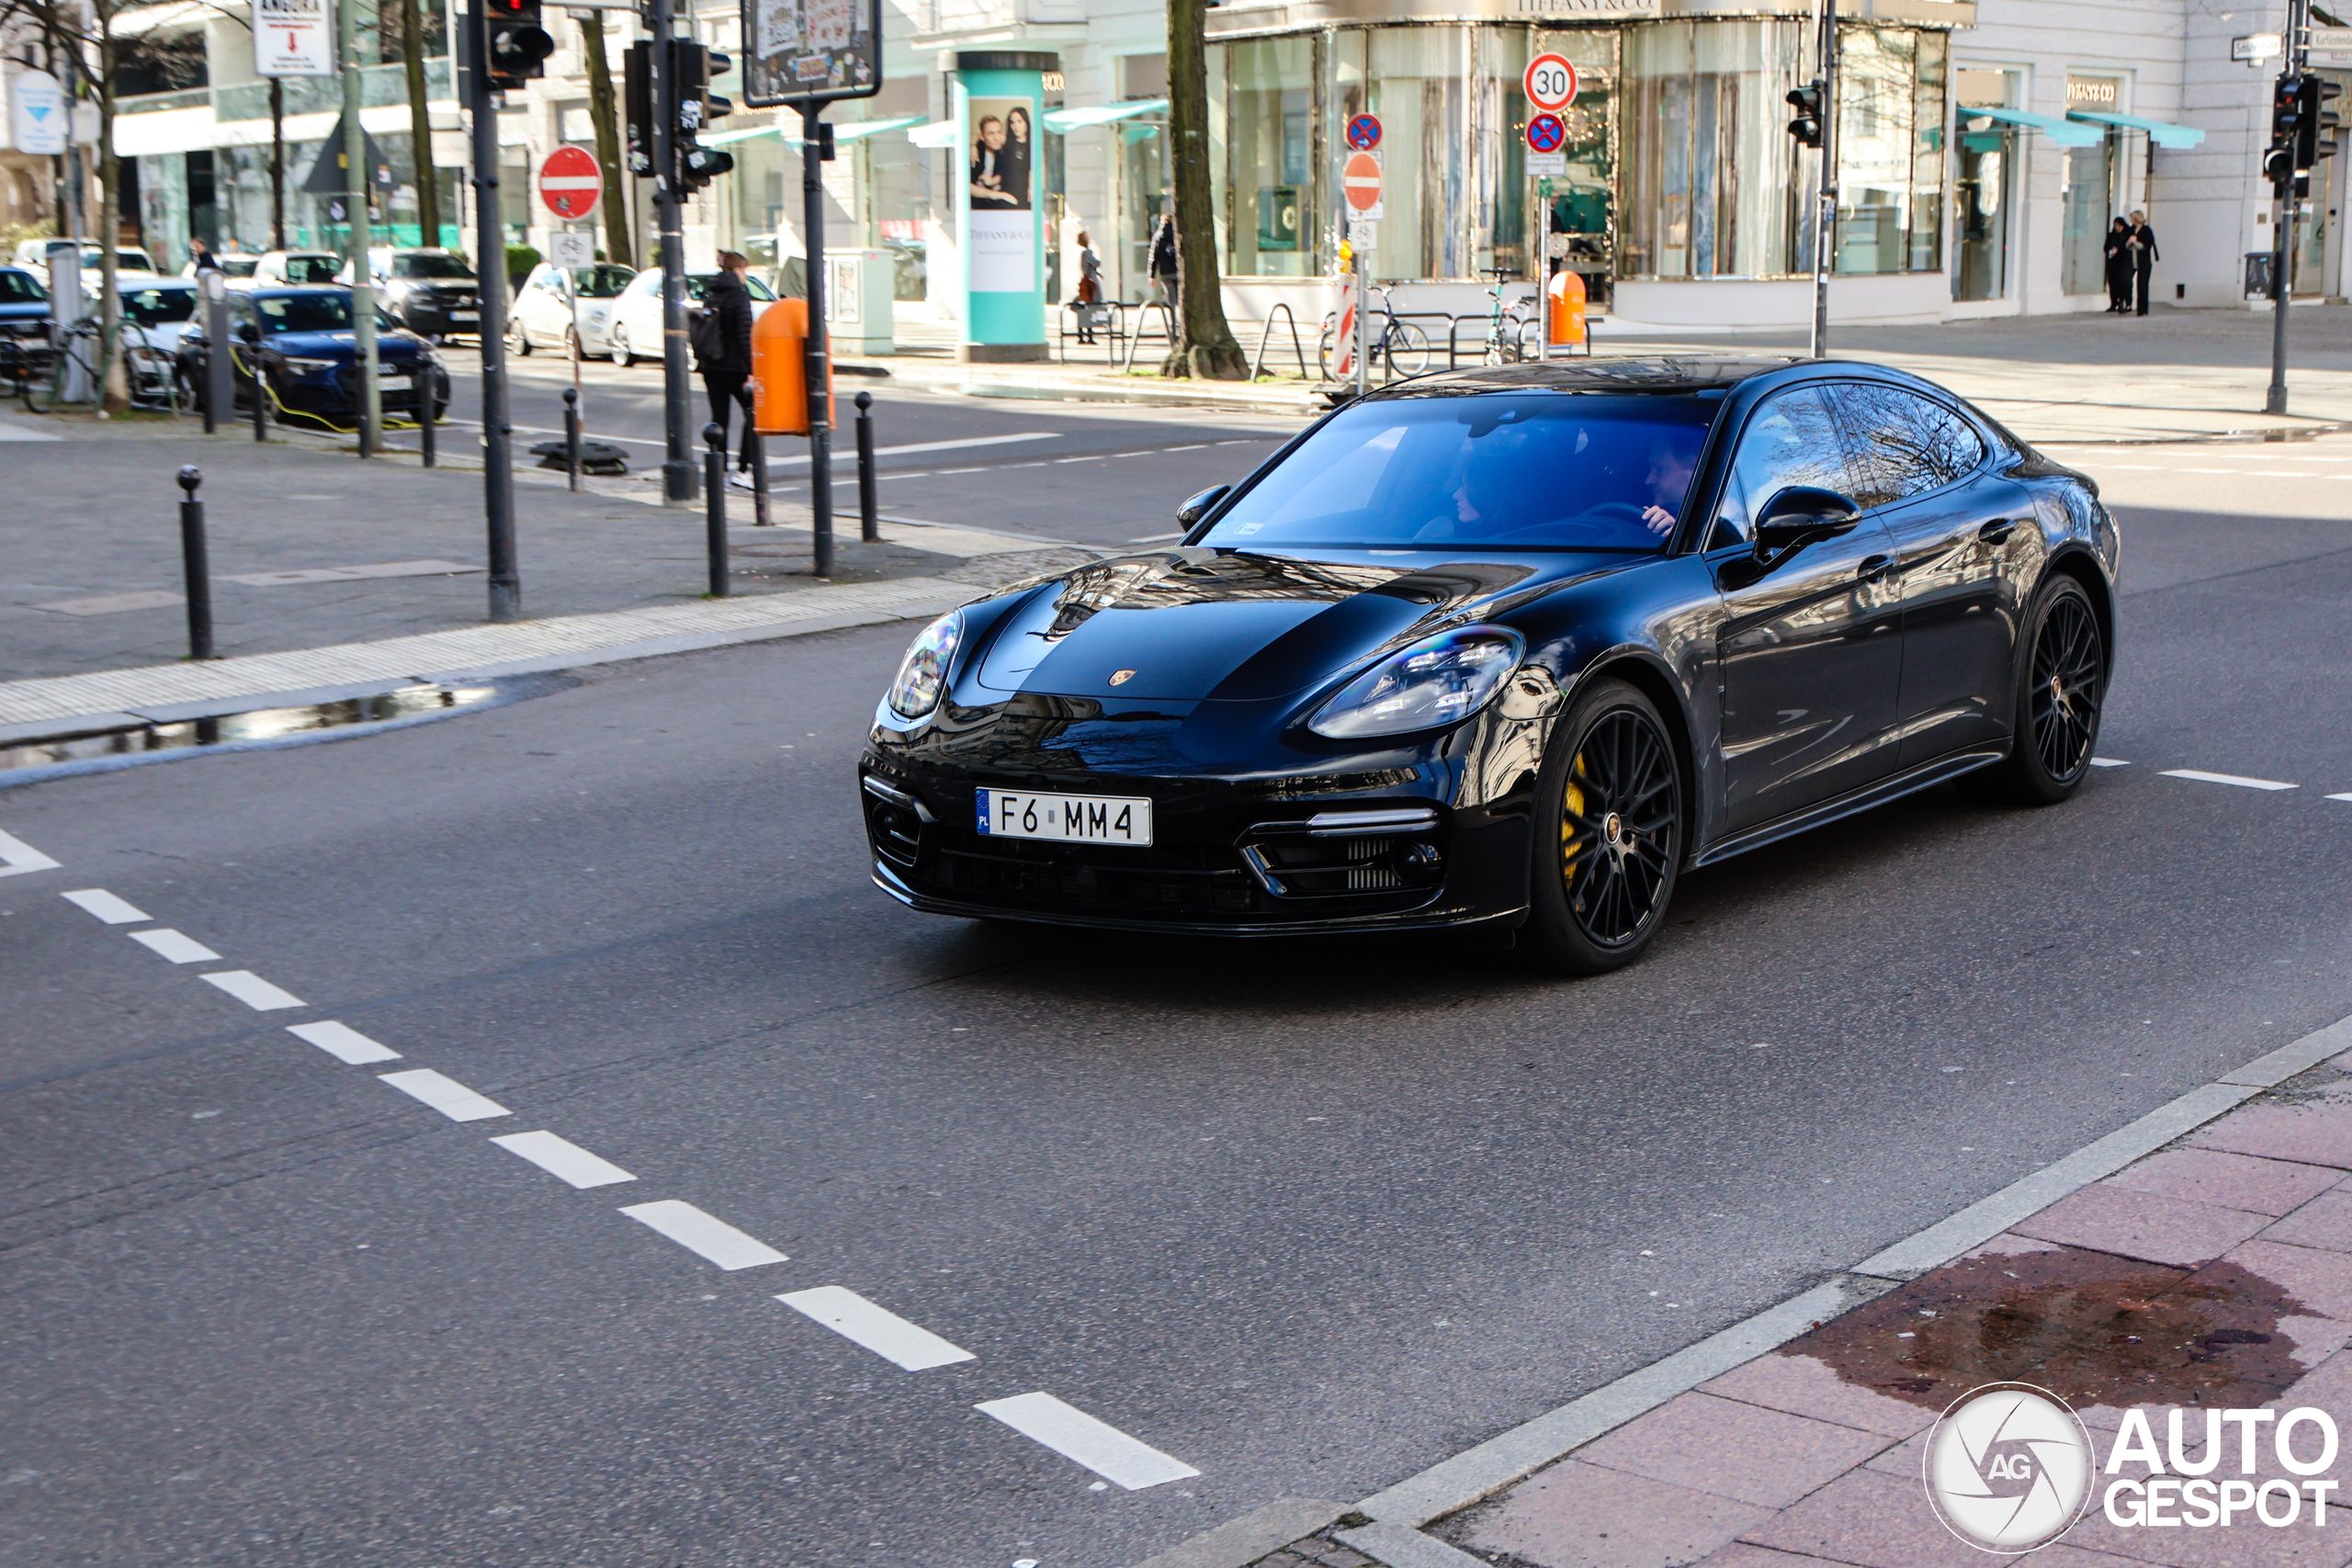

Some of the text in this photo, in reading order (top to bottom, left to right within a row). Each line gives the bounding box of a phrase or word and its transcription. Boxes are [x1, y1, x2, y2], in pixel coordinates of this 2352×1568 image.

[1537, 71, 1565, 95] 30
[978, 815, 989, 827] PL
[1001, 796, 1131, 840] F6 MM4
